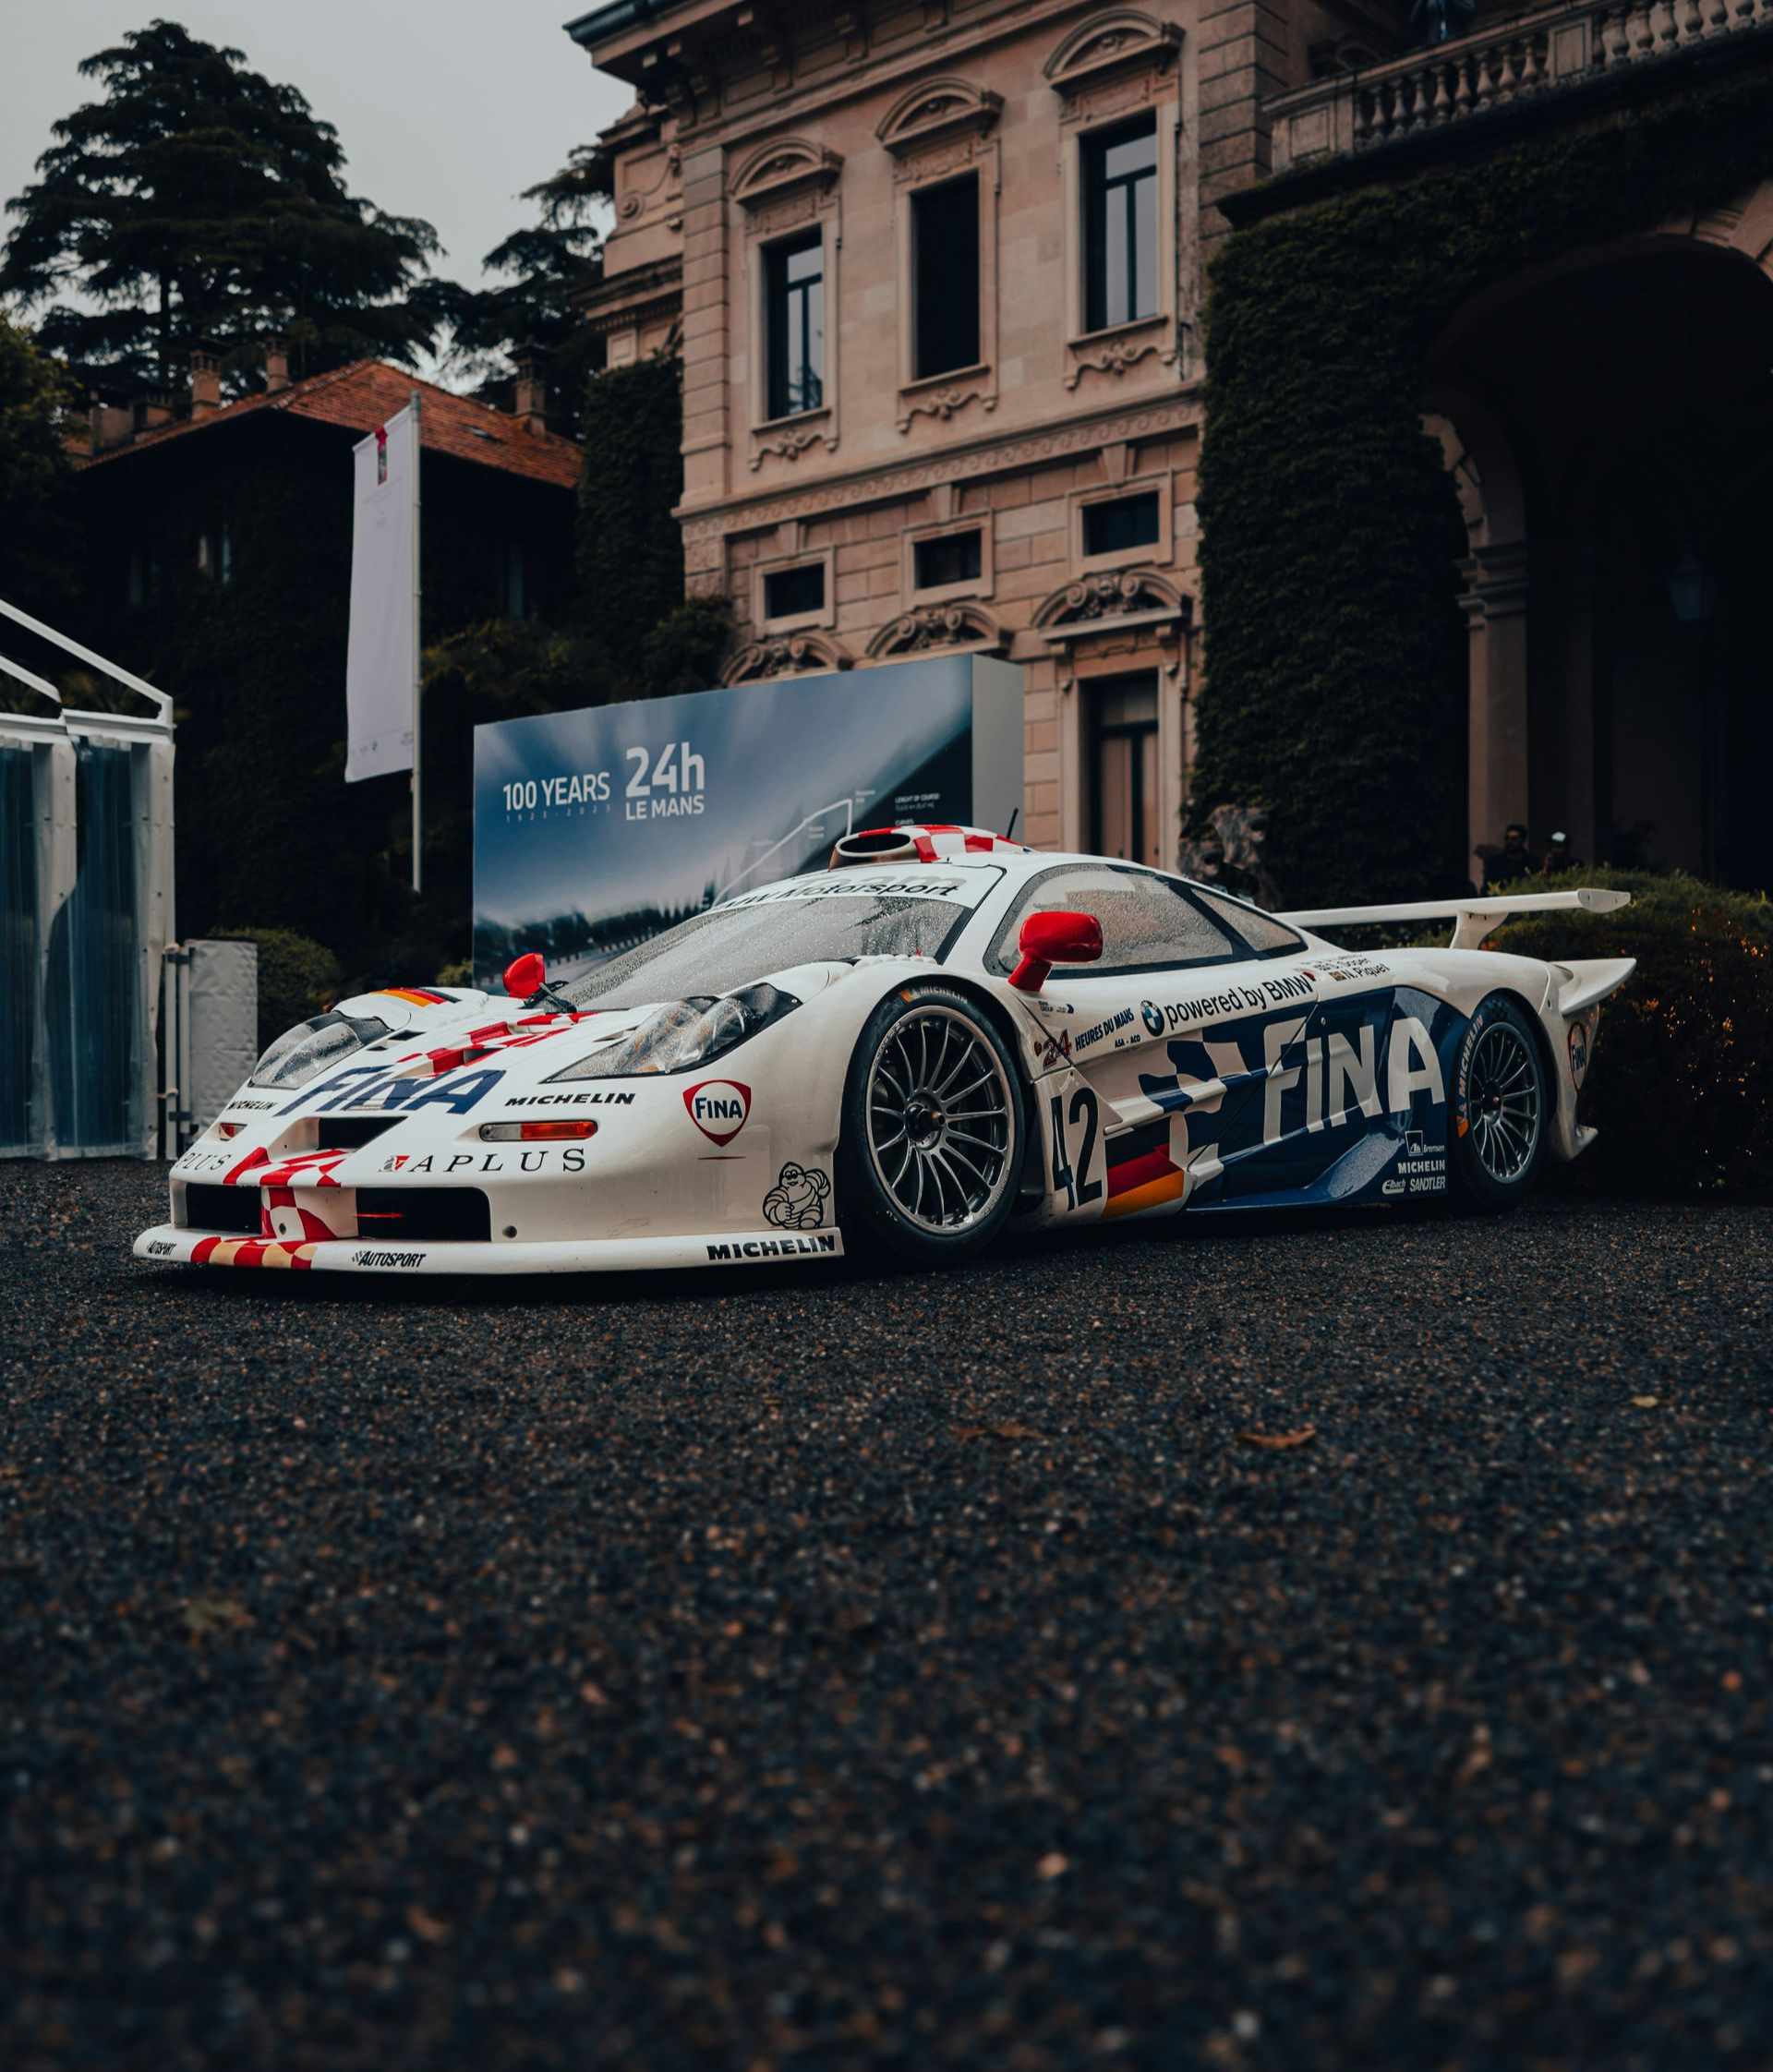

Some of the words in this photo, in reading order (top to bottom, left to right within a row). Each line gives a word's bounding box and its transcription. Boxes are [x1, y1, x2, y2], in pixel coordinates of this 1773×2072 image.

[626, 741, 705, 798] 24h
[503, 781, 537, 812] 100
[541, 772, 610, 807] YEARS
[626, 801, 646, 821] LE
[651, 794, 705, 818] MANS
[775, 884, 960, 899] Motorsport
[919, 986, 968, 1005] MICHELIN
[1164, 988, 1244, 1030] powered
[1237, 987, 1267, 1010] by
[1261, 974, 1314, 1002] BMW
[1075, 1026, 1104, 1052] HEURES
[1103, 1018, 1115, 1036] DU
[1114, 1007, 1135, 1030] MANS
[1115, 1039, 1126, 1048] ASA
[1130, 1034, 1140, 1044] ACO
[1043, 1028, 1072, 1071] 24
[1458, 1014, 1484, 1098] MICHELIN
[274, 1065, 507, 1117] FINA
[1263, 1017, 1445, 1145] FINA
[503, 1092, 636, 1107] MICHELIN
[694, 1096, 743, 1120] FINA
[407, 1148, 586, 1174] APLUS
[1052, 1088, 1103, 1212] 42
[1397, 1159, 1446, 1175] MICHELIN
[1409, 1175, 1446, 1192] SANDTLER
[359, 1250, 427, 1268] AUTOSPORT
[707, 1235, 836, 1260] MICHELIN
